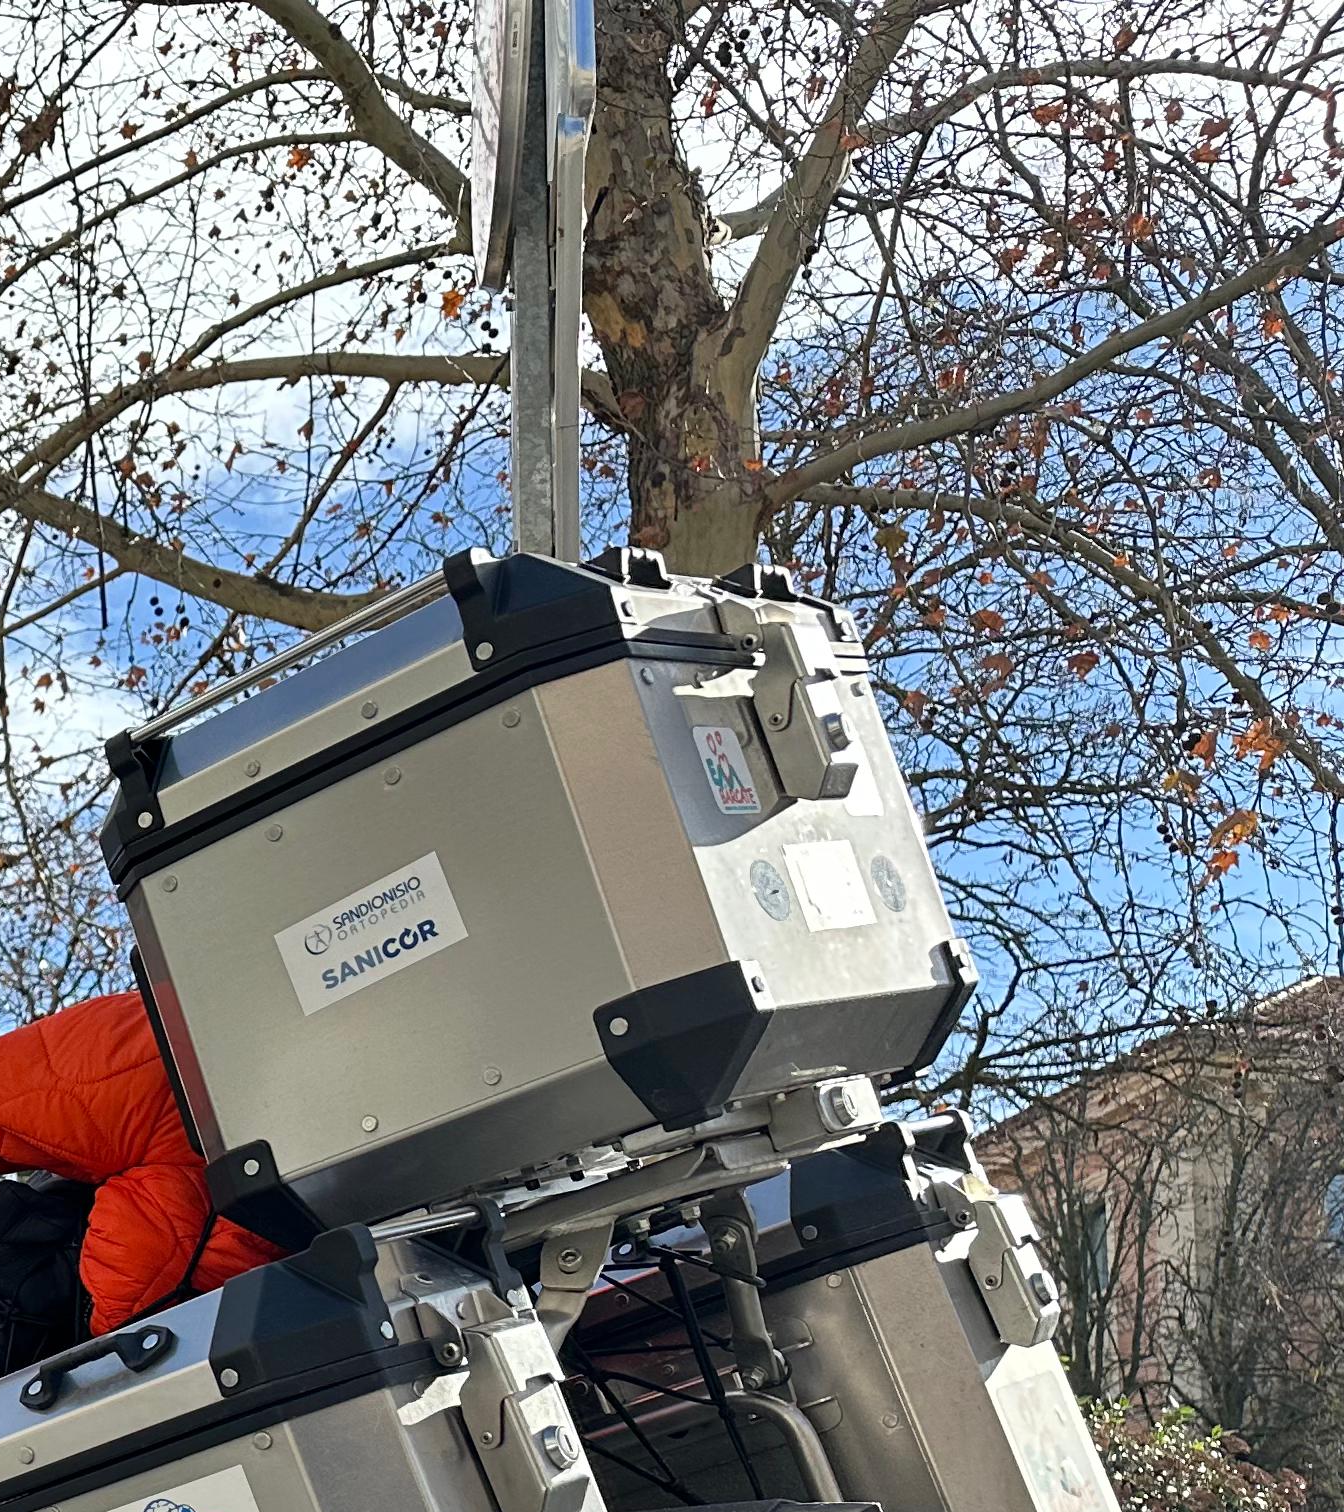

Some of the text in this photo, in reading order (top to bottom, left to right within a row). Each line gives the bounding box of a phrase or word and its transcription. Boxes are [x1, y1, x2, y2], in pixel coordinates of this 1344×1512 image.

[333, 876, 420, 930] SANDIONISIO
[337, 890, 426, 941] ORTOPEDIA
[321, 919, 439, 989] SANICOR
